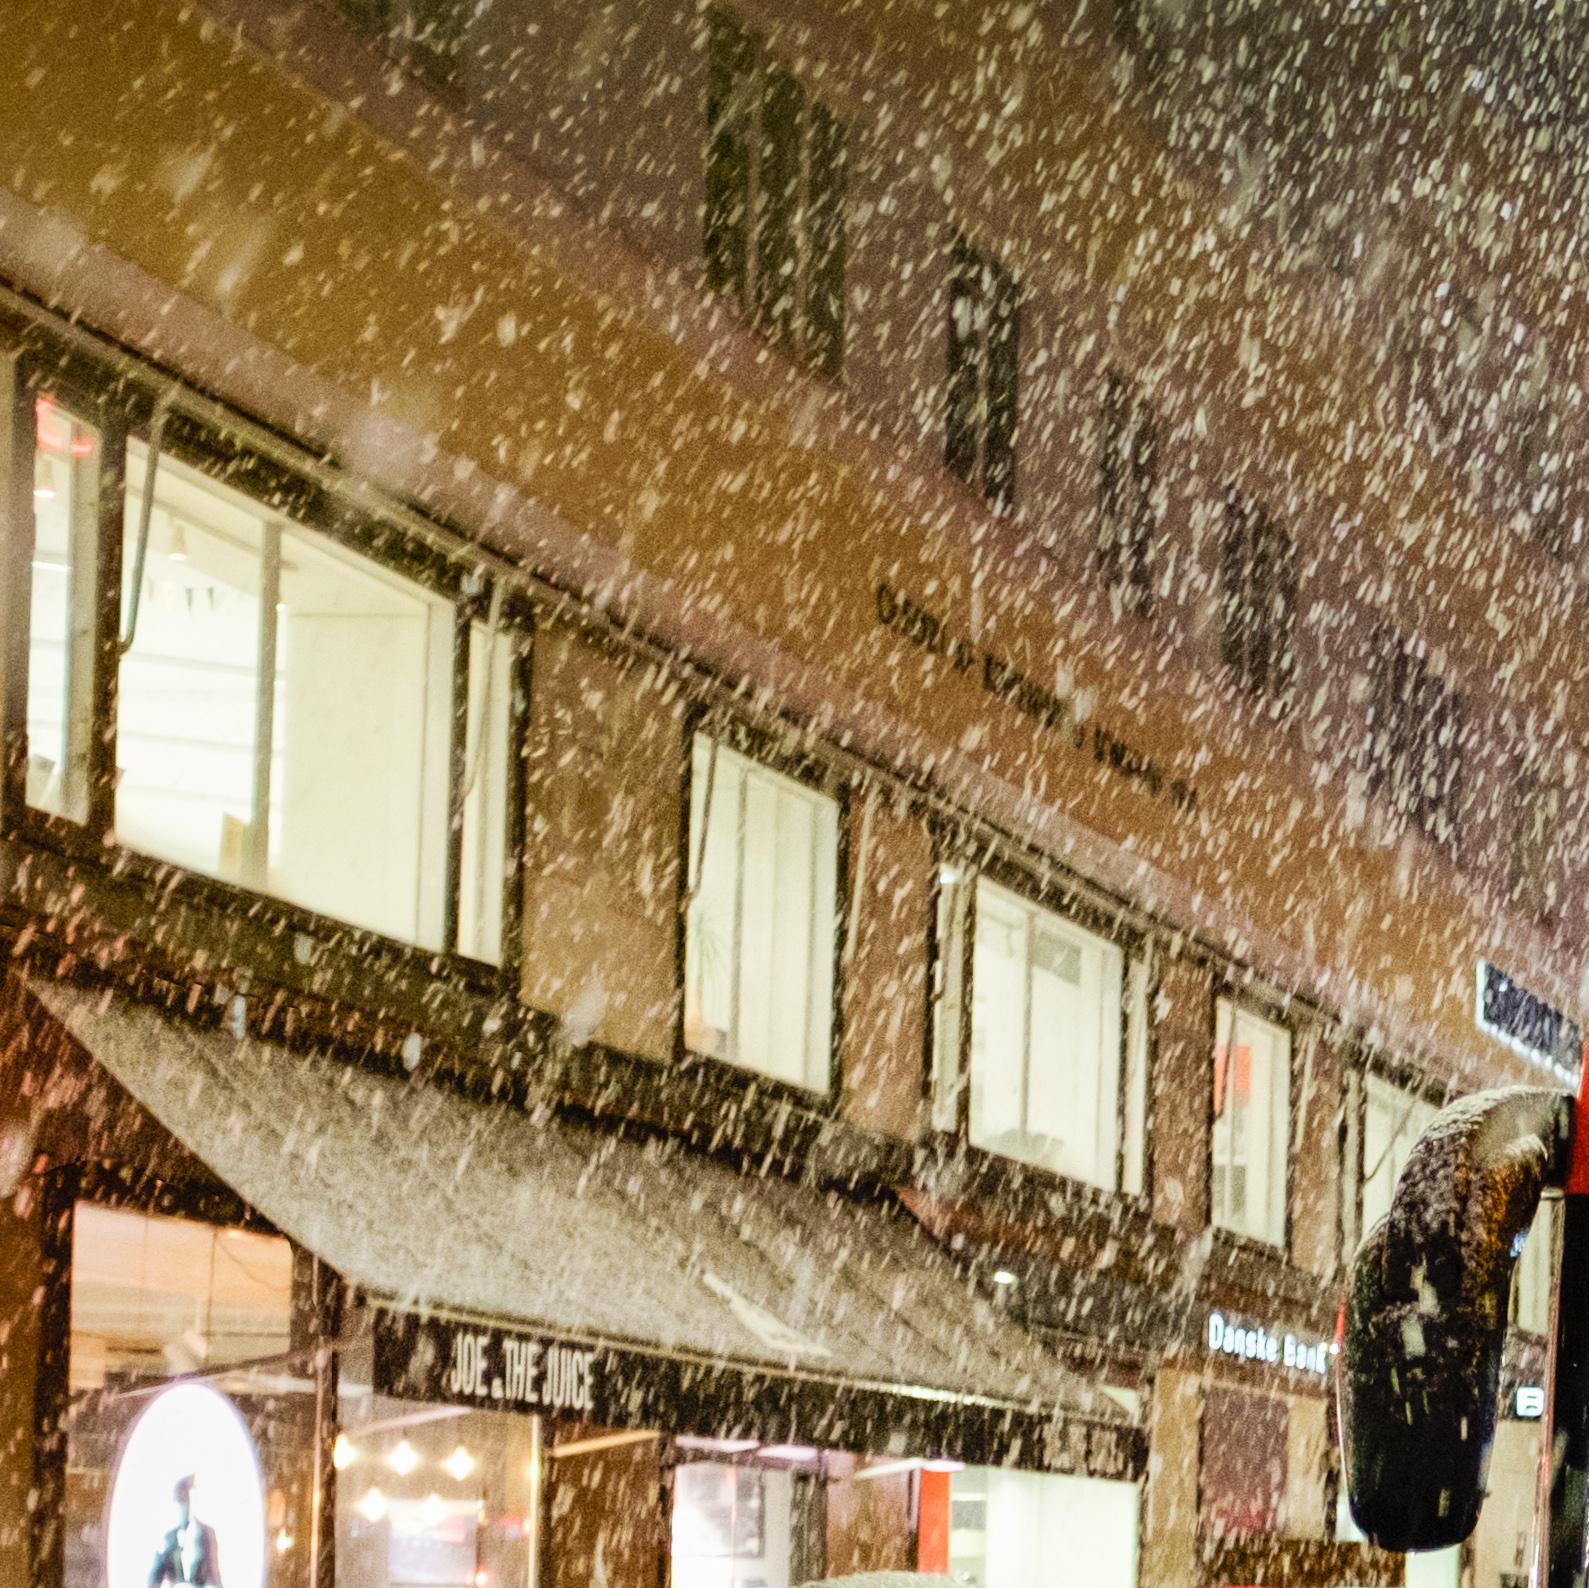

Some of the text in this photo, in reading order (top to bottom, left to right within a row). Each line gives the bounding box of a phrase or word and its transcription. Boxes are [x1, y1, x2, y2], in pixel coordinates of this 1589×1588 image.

[451, 1330, 490, 1396] JOE
[503, 1338, 540, 1403] THE
[542, 1344, 593, 1411] JUICE
[1208, 1312, 1278, 1363] Danske
